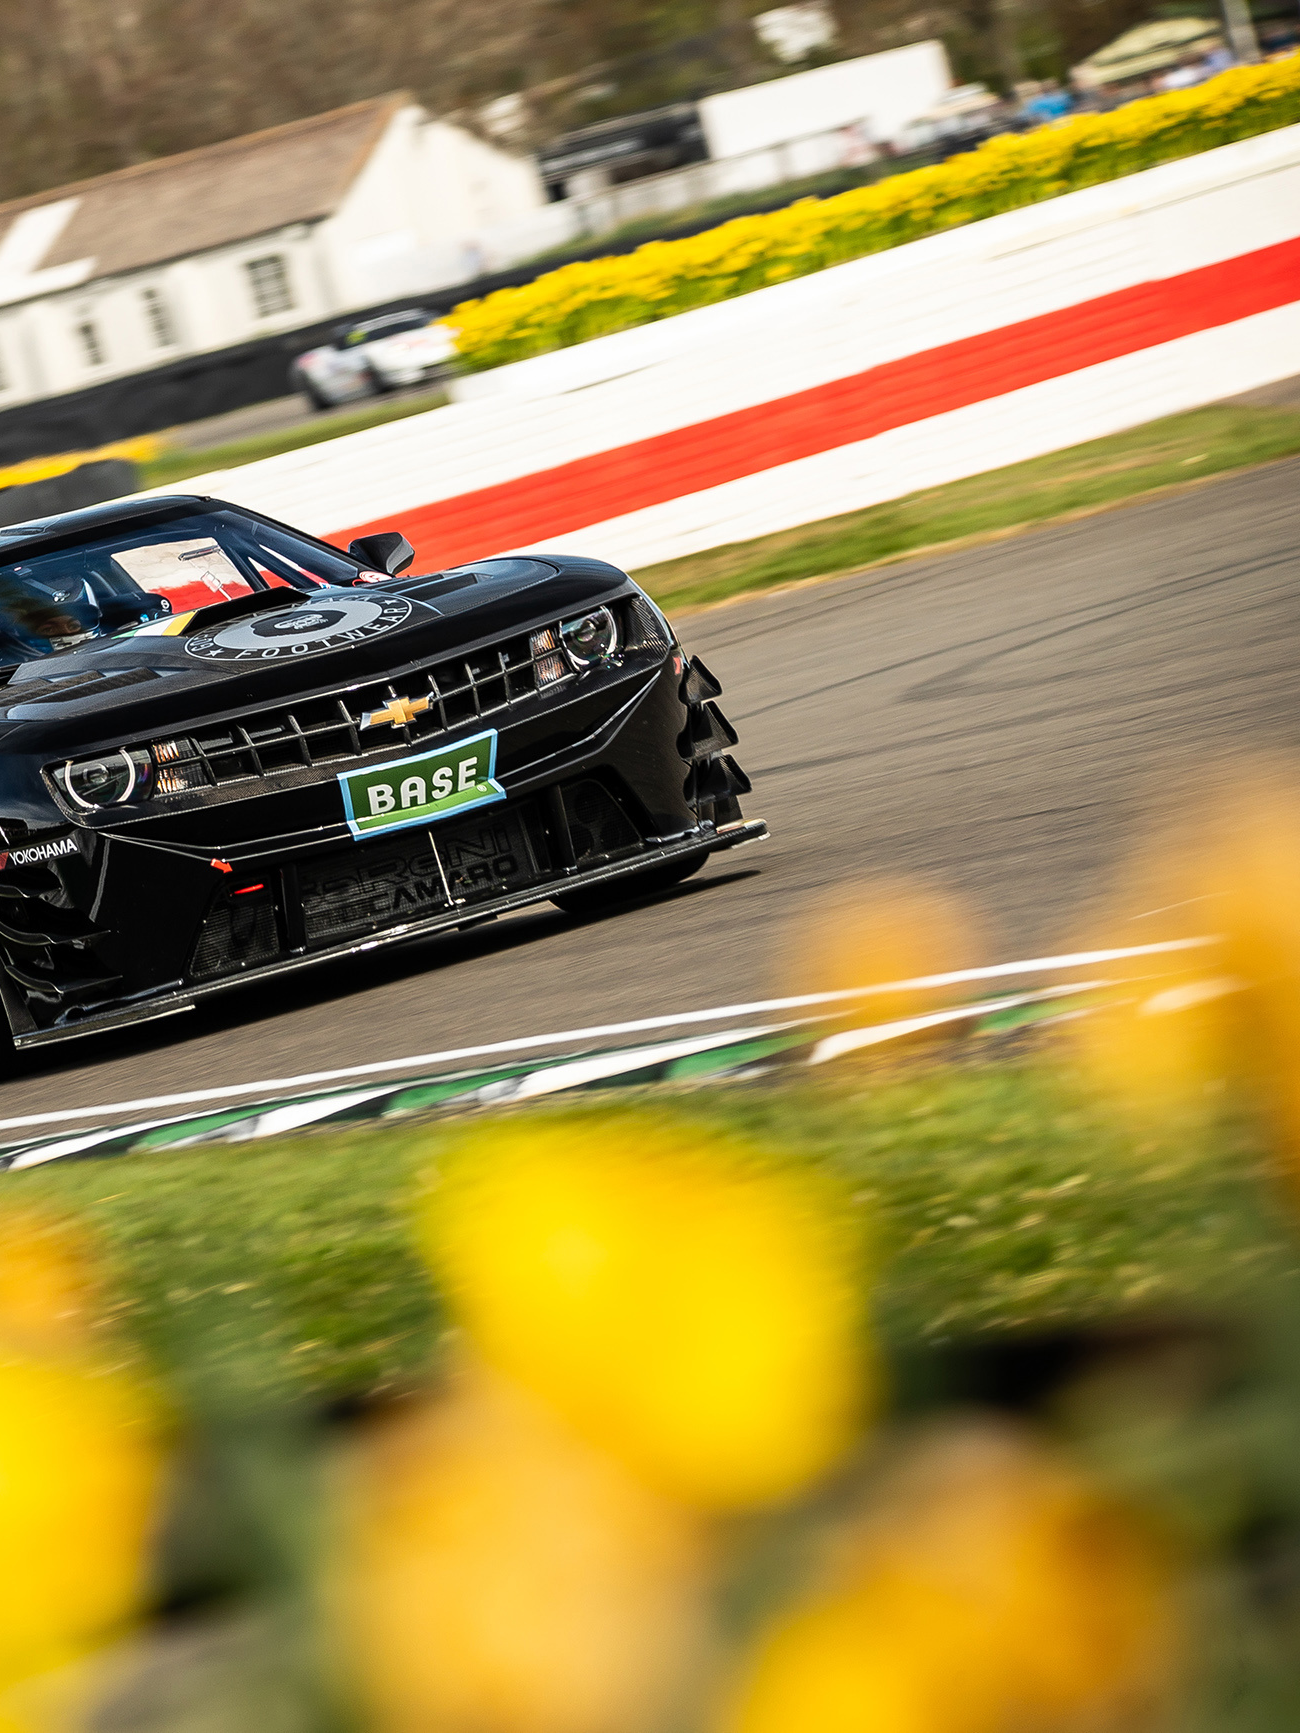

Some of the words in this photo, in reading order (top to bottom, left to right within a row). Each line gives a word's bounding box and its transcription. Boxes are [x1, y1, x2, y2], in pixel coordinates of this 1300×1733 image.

[235, 605, 409, 658] FOOTWEAR
[367, 756, 478, 815] BASE
[10, 837, 78, 866] YOKOHAMA
